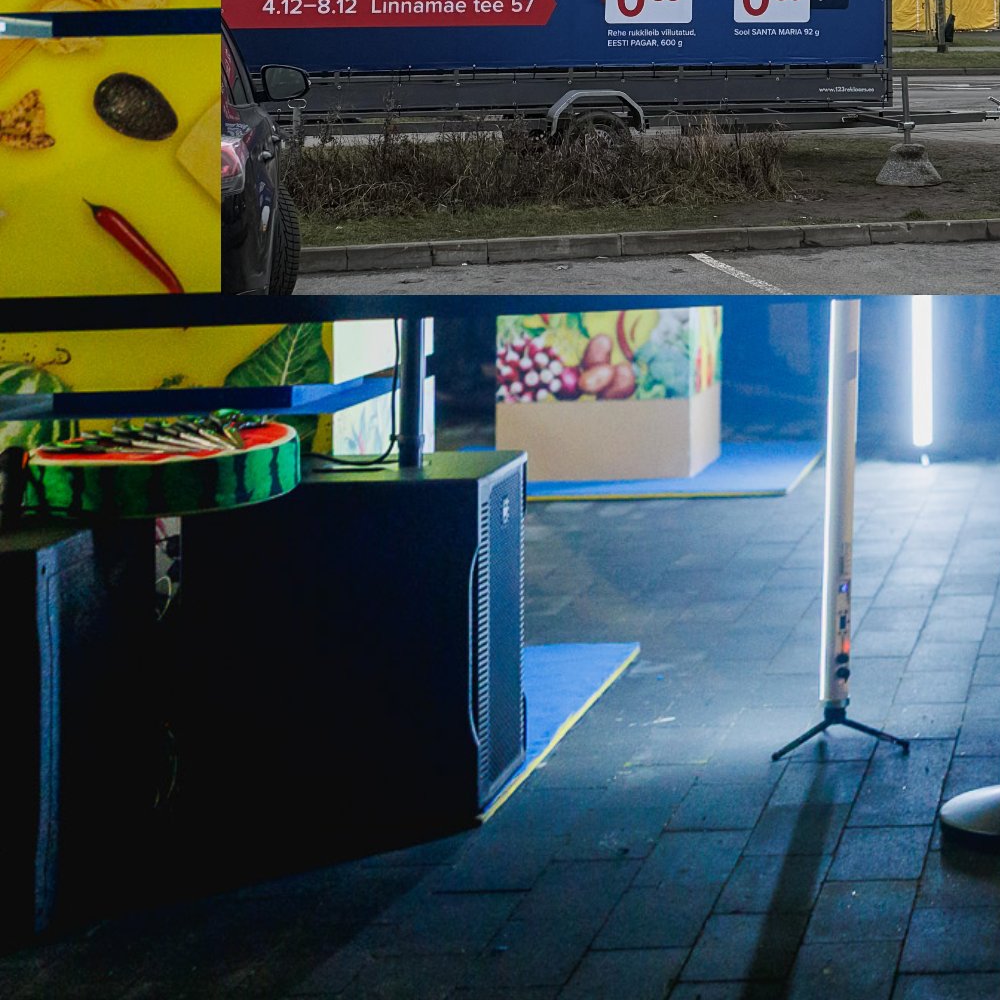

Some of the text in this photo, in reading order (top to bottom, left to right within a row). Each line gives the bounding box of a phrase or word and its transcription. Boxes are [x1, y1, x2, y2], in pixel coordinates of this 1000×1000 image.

[734, 28, 750, 36] Sool
[751, 28, 777, 36] SANTA
[778, 28, 802, 36] MARIA
[803, 28, 814, 36] 92
[607, 39, 683, 48] EESTI PAGAR, 600 g
